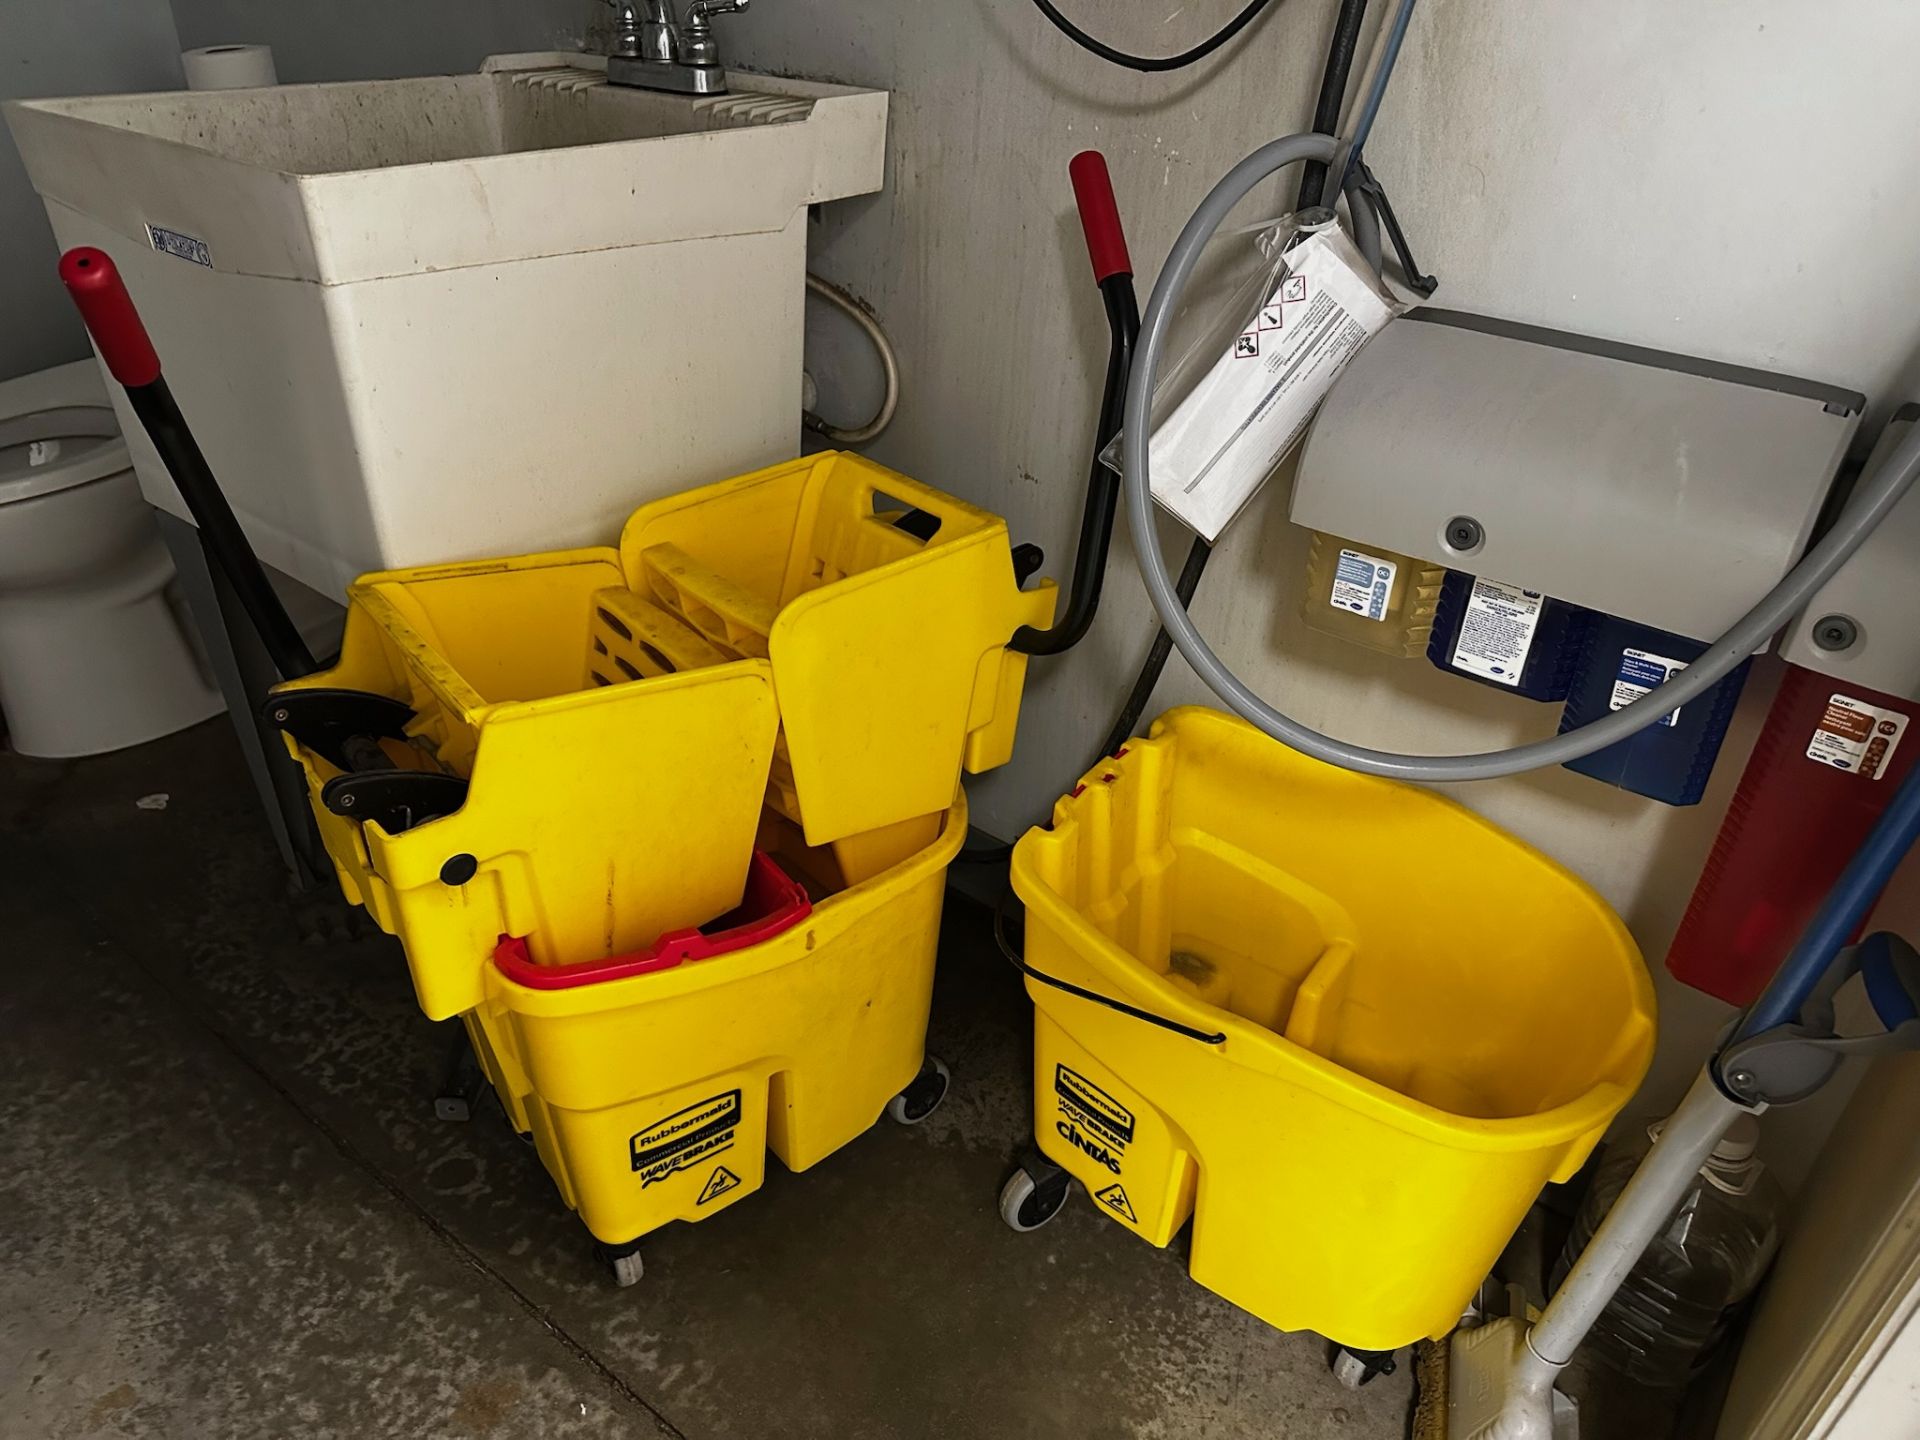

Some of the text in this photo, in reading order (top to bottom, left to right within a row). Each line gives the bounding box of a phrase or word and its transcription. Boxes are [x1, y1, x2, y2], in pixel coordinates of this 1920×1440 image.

[1062, 1073, 1127, 1123] Rubbermaid
[641, 1099, 731, 1147] Rubbermaid
[636, 1138, 694, 1167] Commercial
